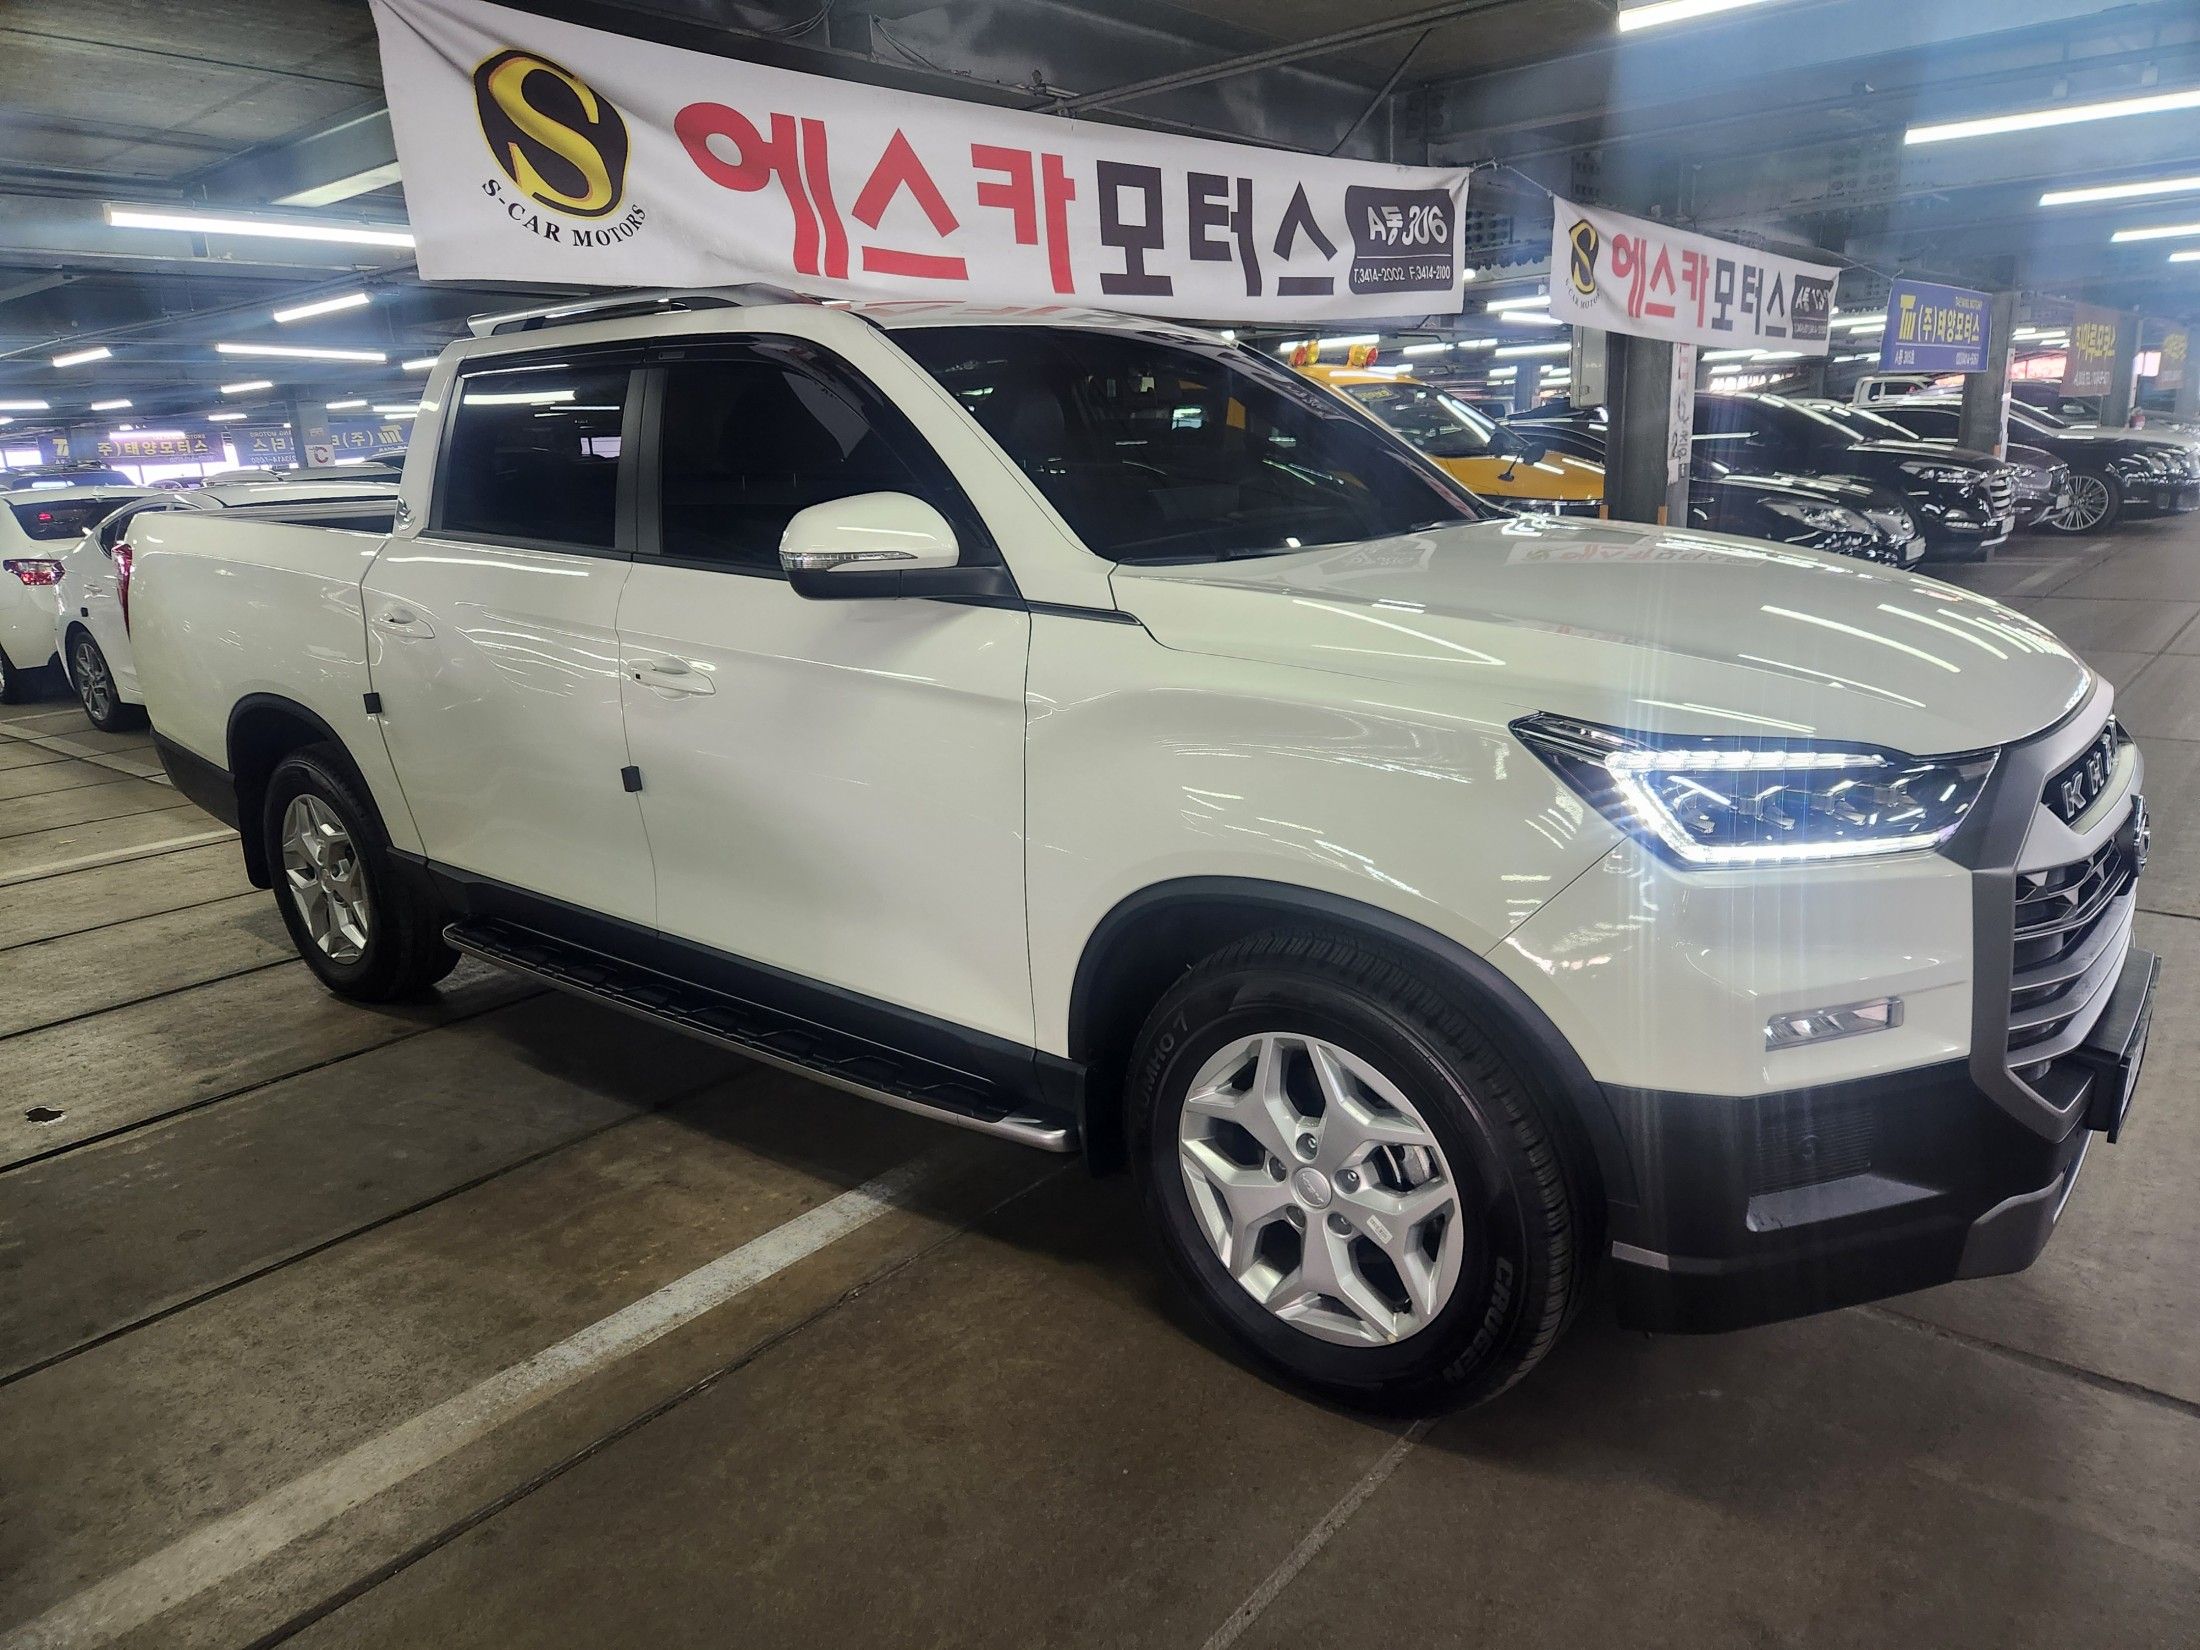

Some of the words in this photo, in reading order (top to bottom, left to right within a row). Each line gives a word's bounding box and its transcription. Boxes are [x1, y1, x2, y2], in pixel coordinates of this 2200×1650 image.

[482, 177, 561, 243] S-CAR
[572, 203, 647, 248] MOTORS
[673, 101, 1339, 297] 에스카모터스
[1611, 233, 1787, 338] 에스카모터스
[97, 439, 209, 457] 주)태양모터스
